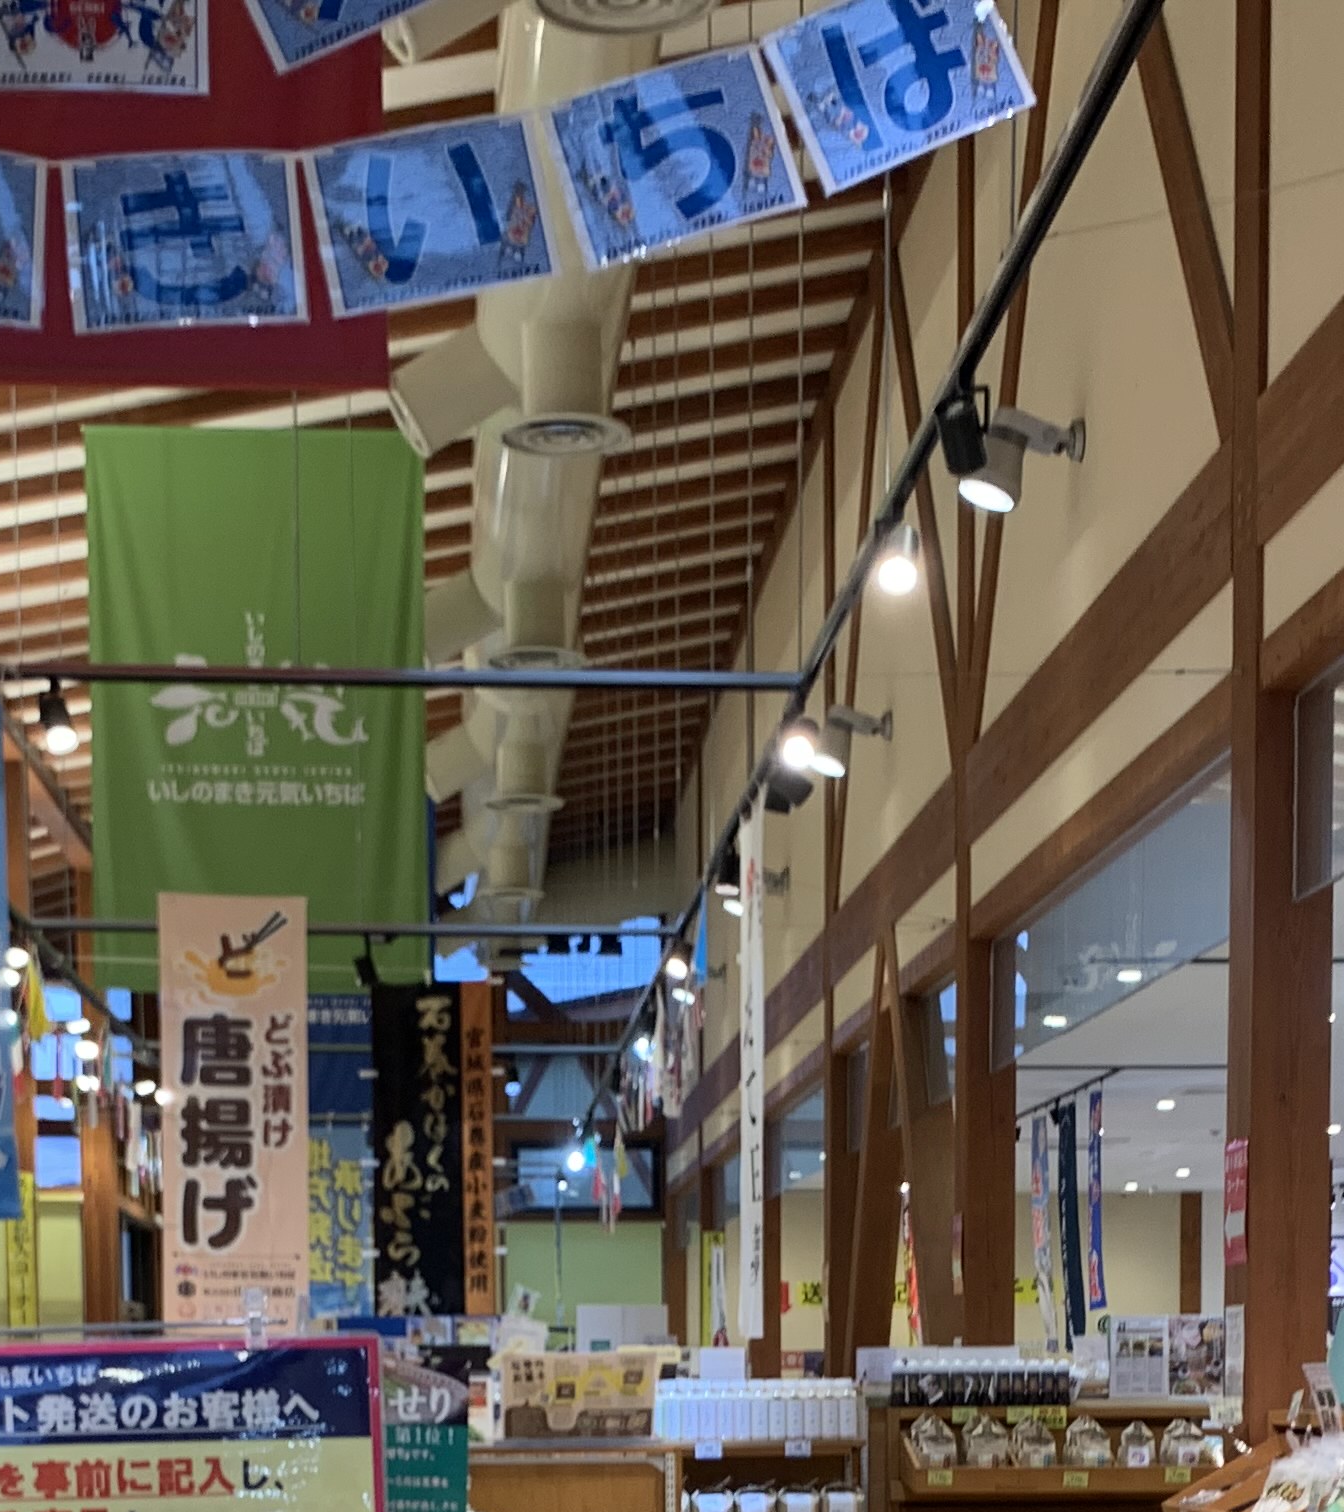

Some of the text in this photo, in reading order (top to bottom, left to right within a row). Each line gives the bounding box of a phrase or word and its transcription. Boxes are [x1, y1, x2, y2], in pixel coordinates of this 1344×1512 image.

[180, 1013, 258, 1250] 唐揚げ
[261, 1013, 294, 1150] どぶ漬け
[387, 1383, 452, 1424] せり
